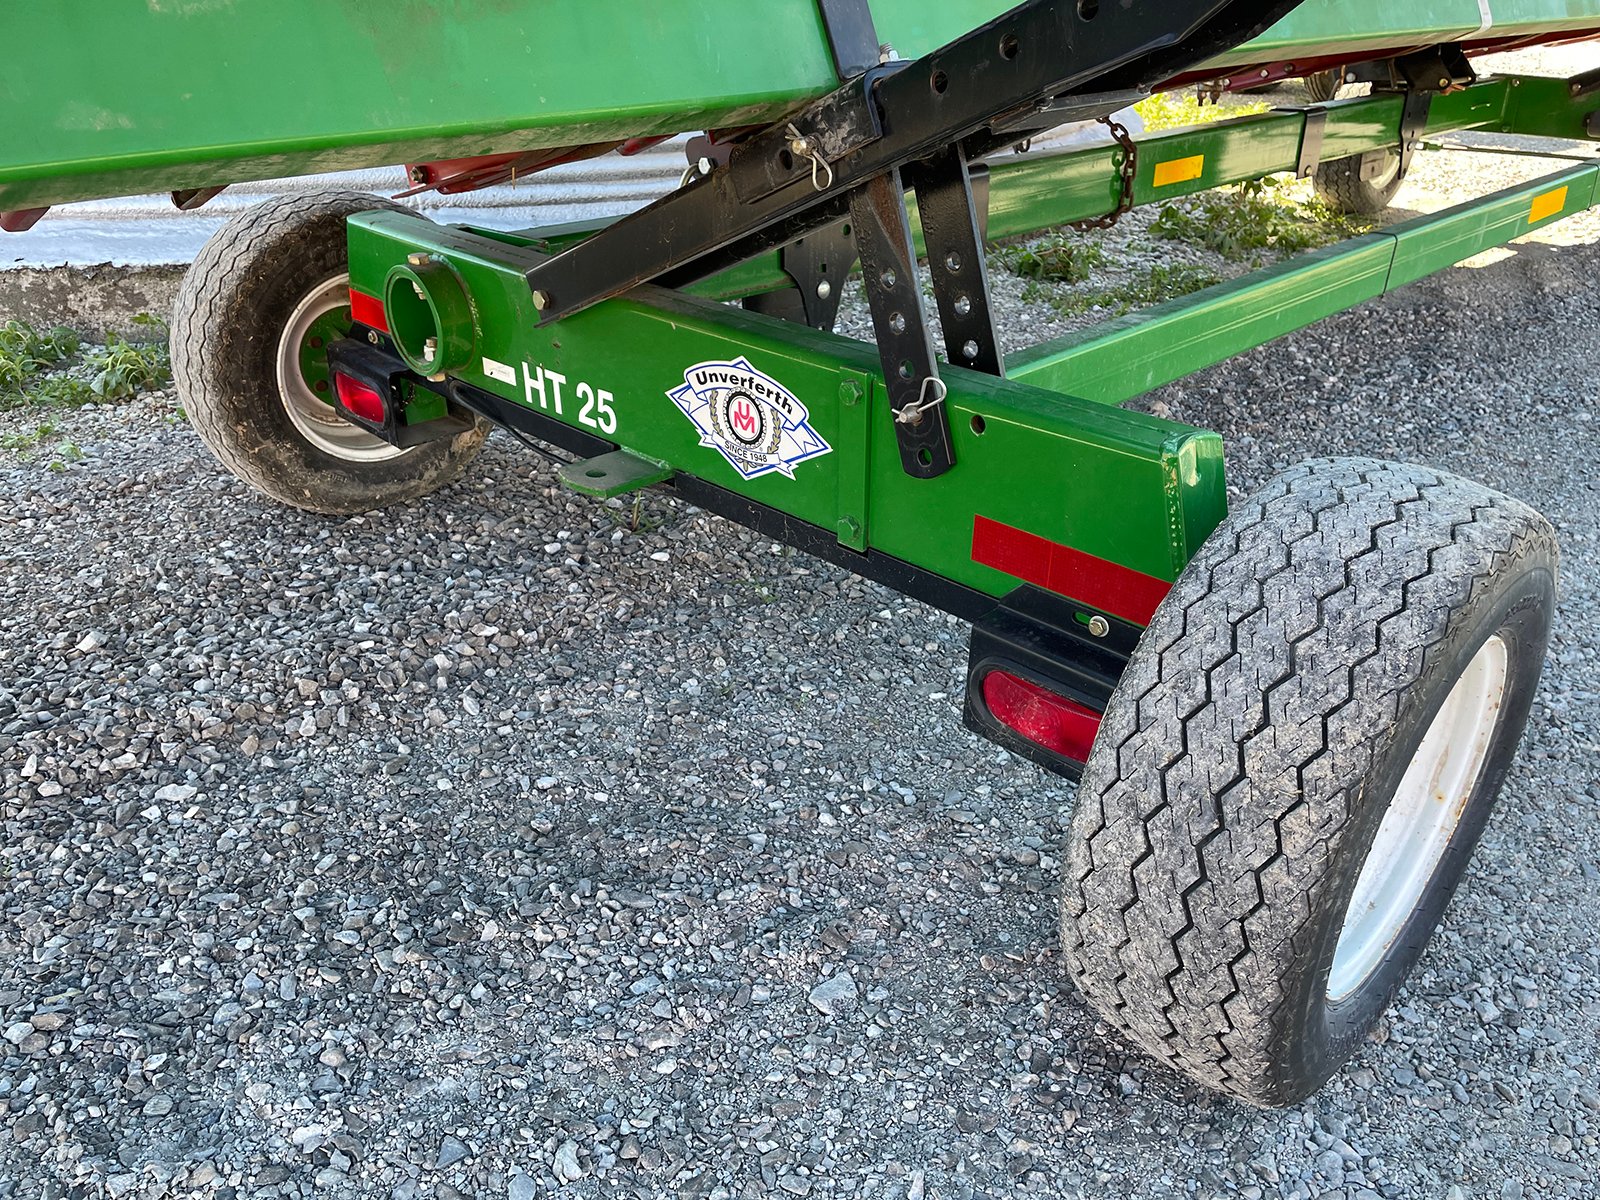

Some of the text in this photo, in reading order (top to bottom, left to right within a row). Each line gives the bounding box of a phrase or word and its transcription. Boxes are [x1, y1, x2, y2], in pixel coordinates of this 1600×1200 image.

[521, 361, 617, 435] HT 25
[695, 370, 793, 415] Unverferth
[724, 440, 768, 463] SINCE 1948
